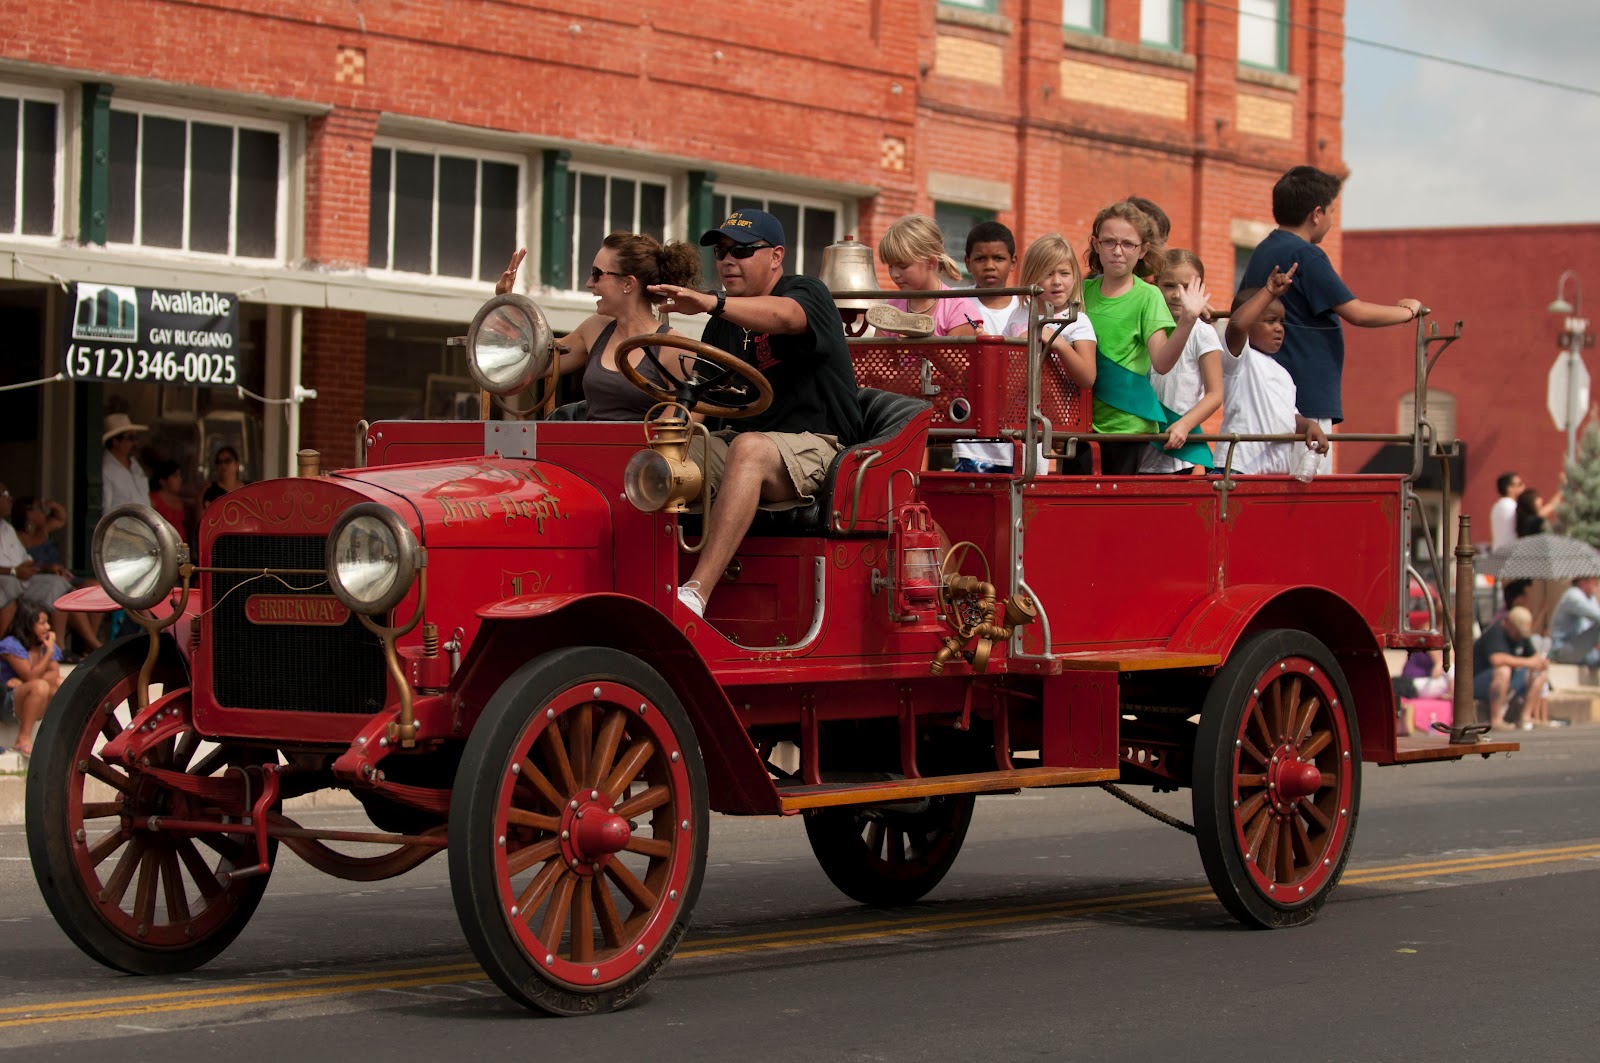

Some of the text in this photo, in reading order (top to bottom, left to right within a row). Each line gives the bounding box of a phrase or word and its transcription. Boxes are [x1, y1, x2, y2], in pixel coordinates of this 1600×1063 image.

[150, 289, 231, 317] Available
[150, 327, 233, 349] GAY RUGGIANO
[66, 343, 236, 385] (512)346-0025
[435, 488, 569, 536] Fire Dept.
[260, 600, 337, 620] BROCKWAY
